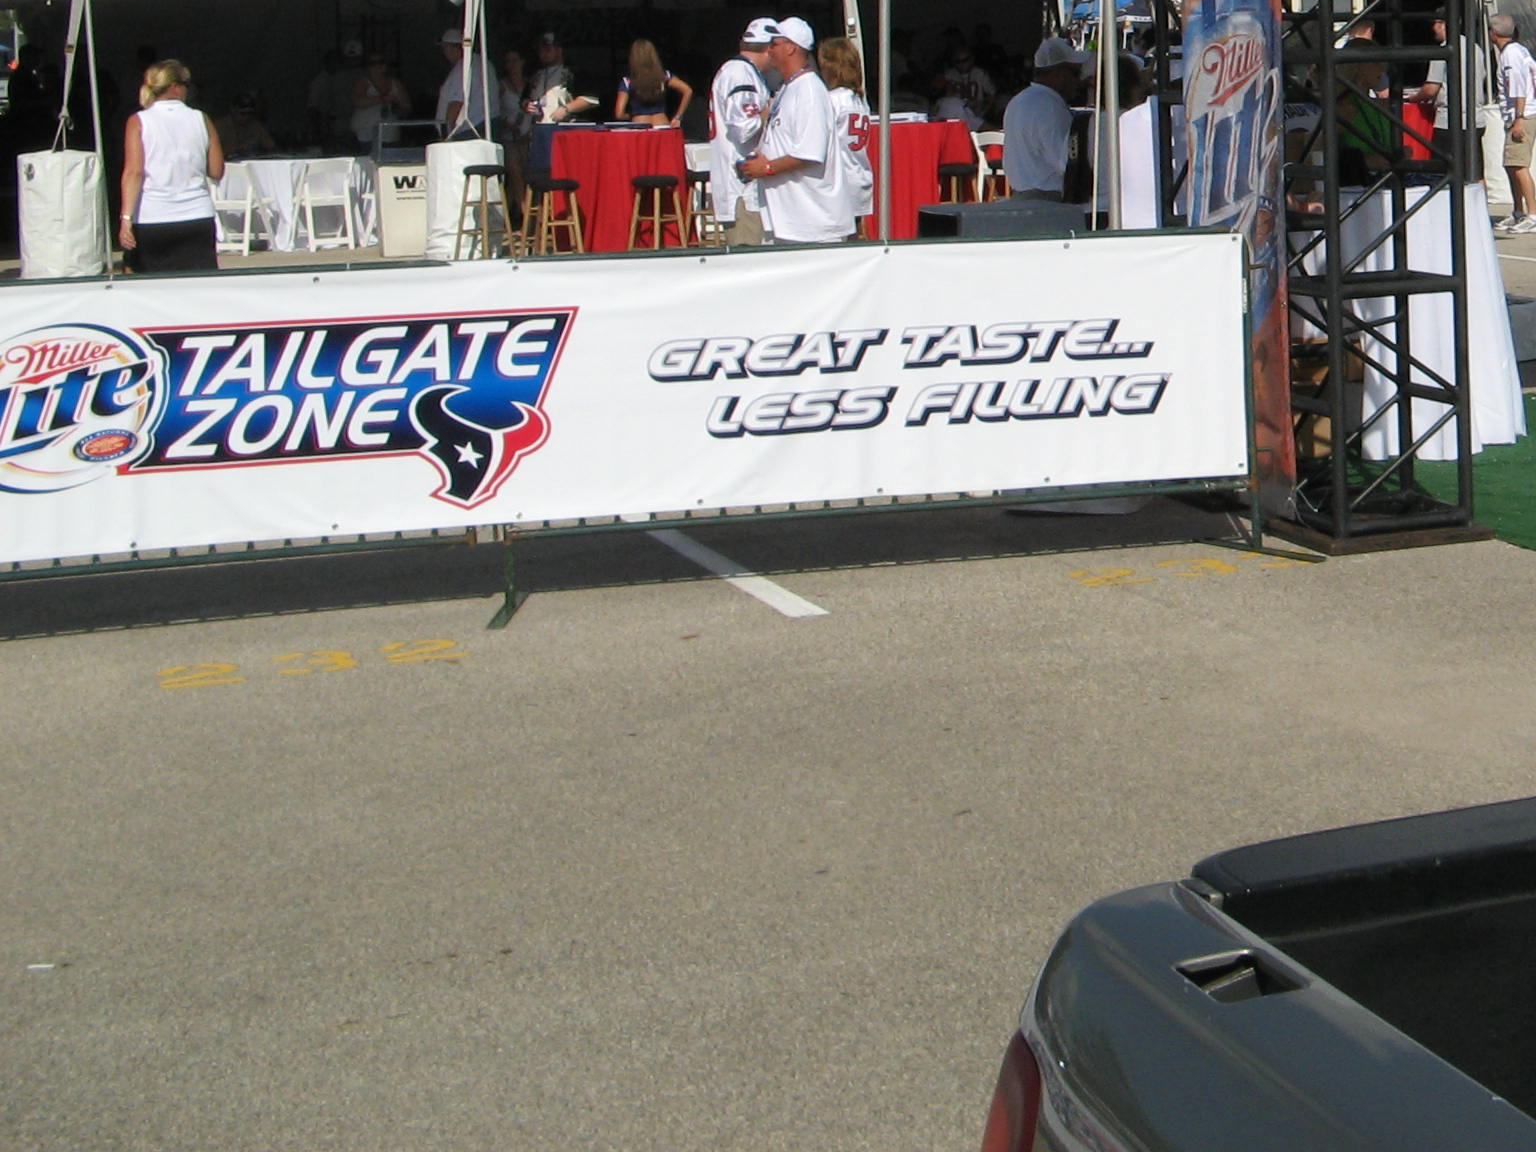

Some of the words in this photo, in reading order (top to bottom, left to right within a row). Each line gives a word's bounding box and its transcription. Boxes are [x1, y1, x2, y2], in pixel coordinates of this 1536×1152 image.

[1202, 34, 1266, 97] Mille
[5, 341, 120, 378] Miller
[179, 317, 556, 397] TAILGATE
[648, 328, 889, 382] GREAT
[901, 318, 1154, 369] TASTE...
[166, 386, 410, 459] ZONE
[705, 386, 898, 438] LESS
[904, 374, 1168, 427] FILLING
